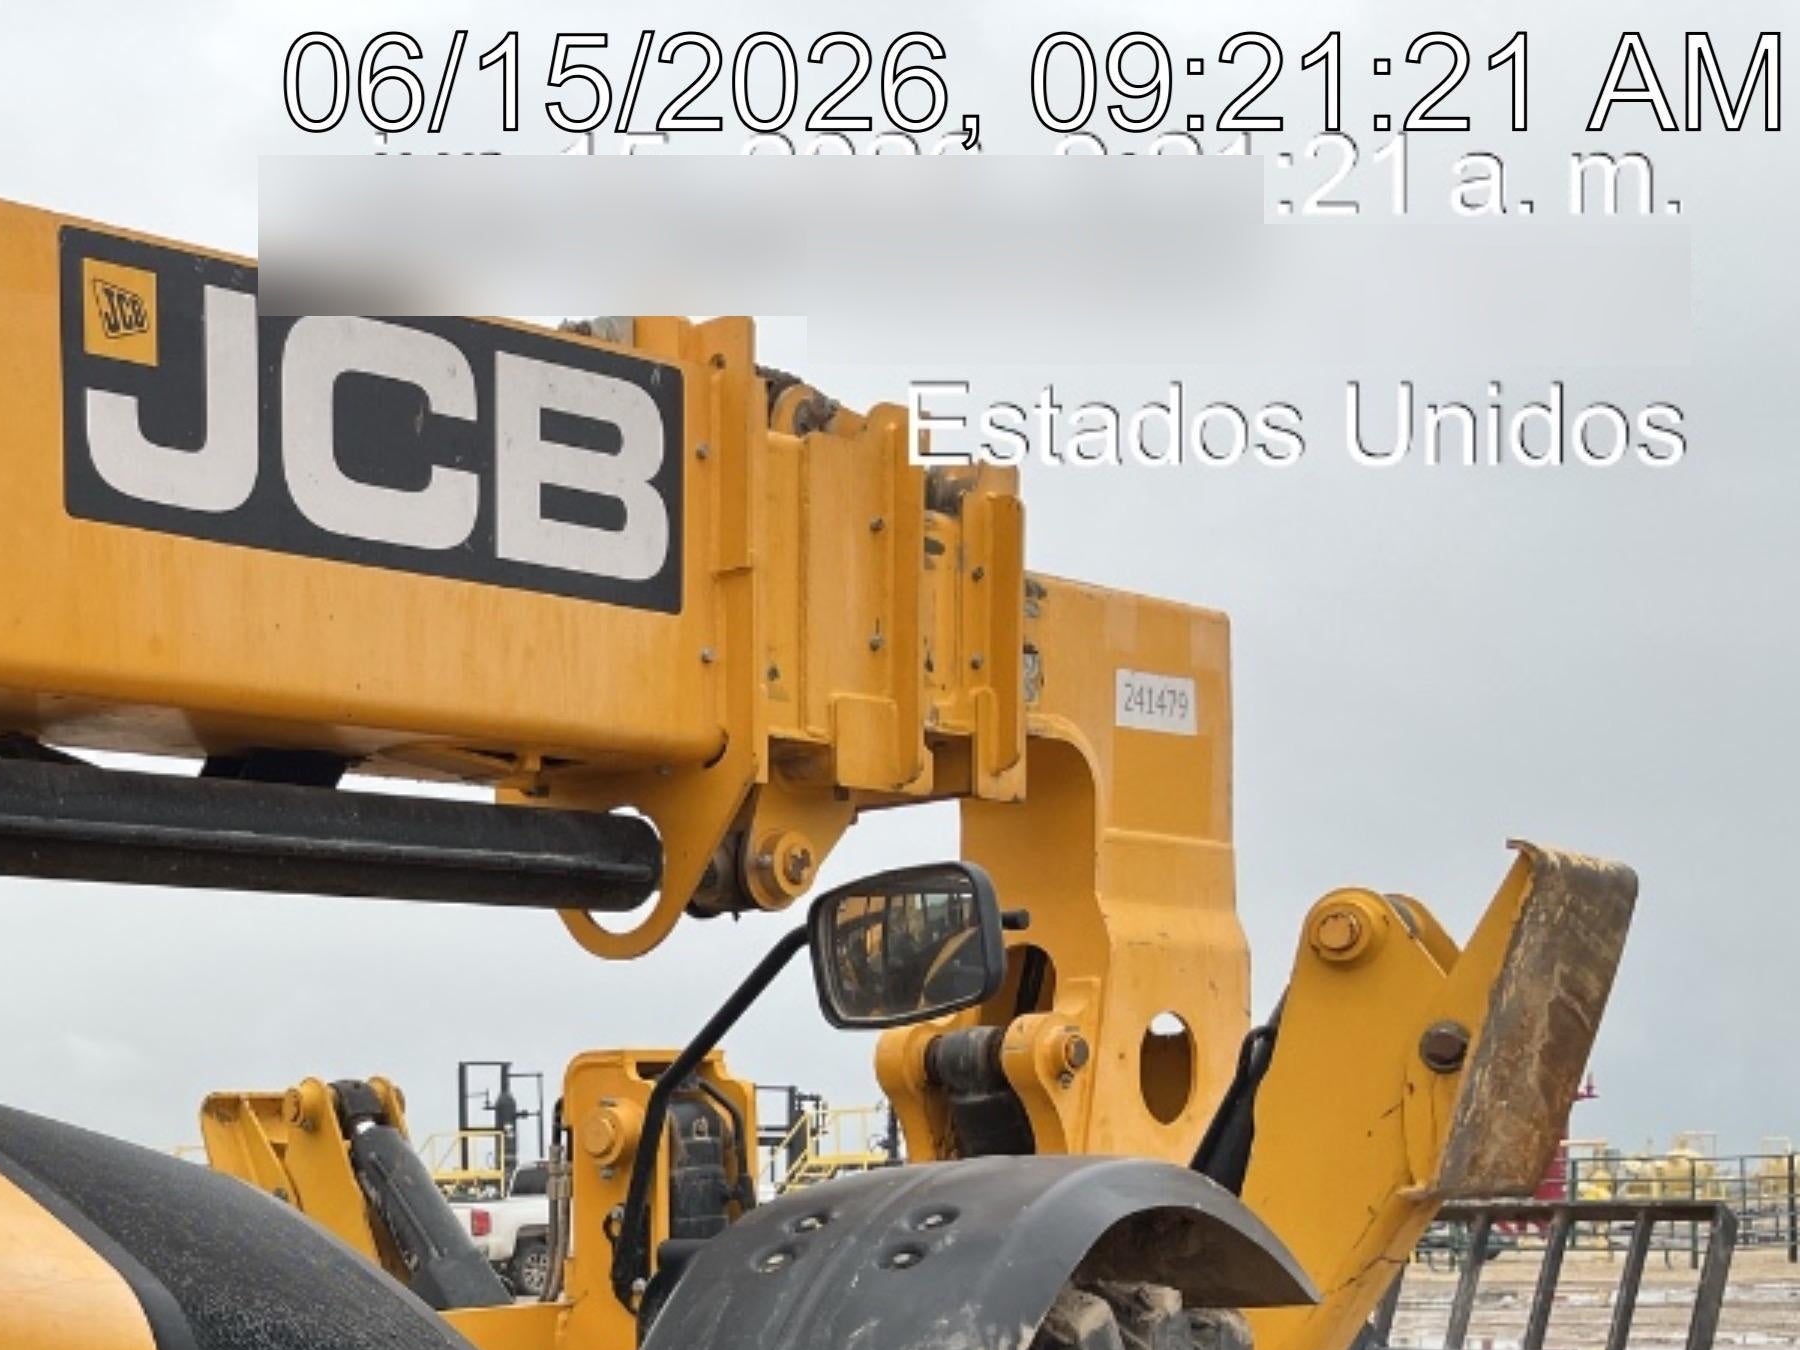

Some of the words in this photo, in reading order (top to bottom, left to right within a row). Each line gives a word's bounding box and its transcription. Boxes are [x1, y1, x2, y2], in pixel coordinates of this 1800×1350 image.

[102, 286, 145, 333] JCB
[85, 283, 669, 581] JCB
[1123, 683, 1189, 721] 241479
